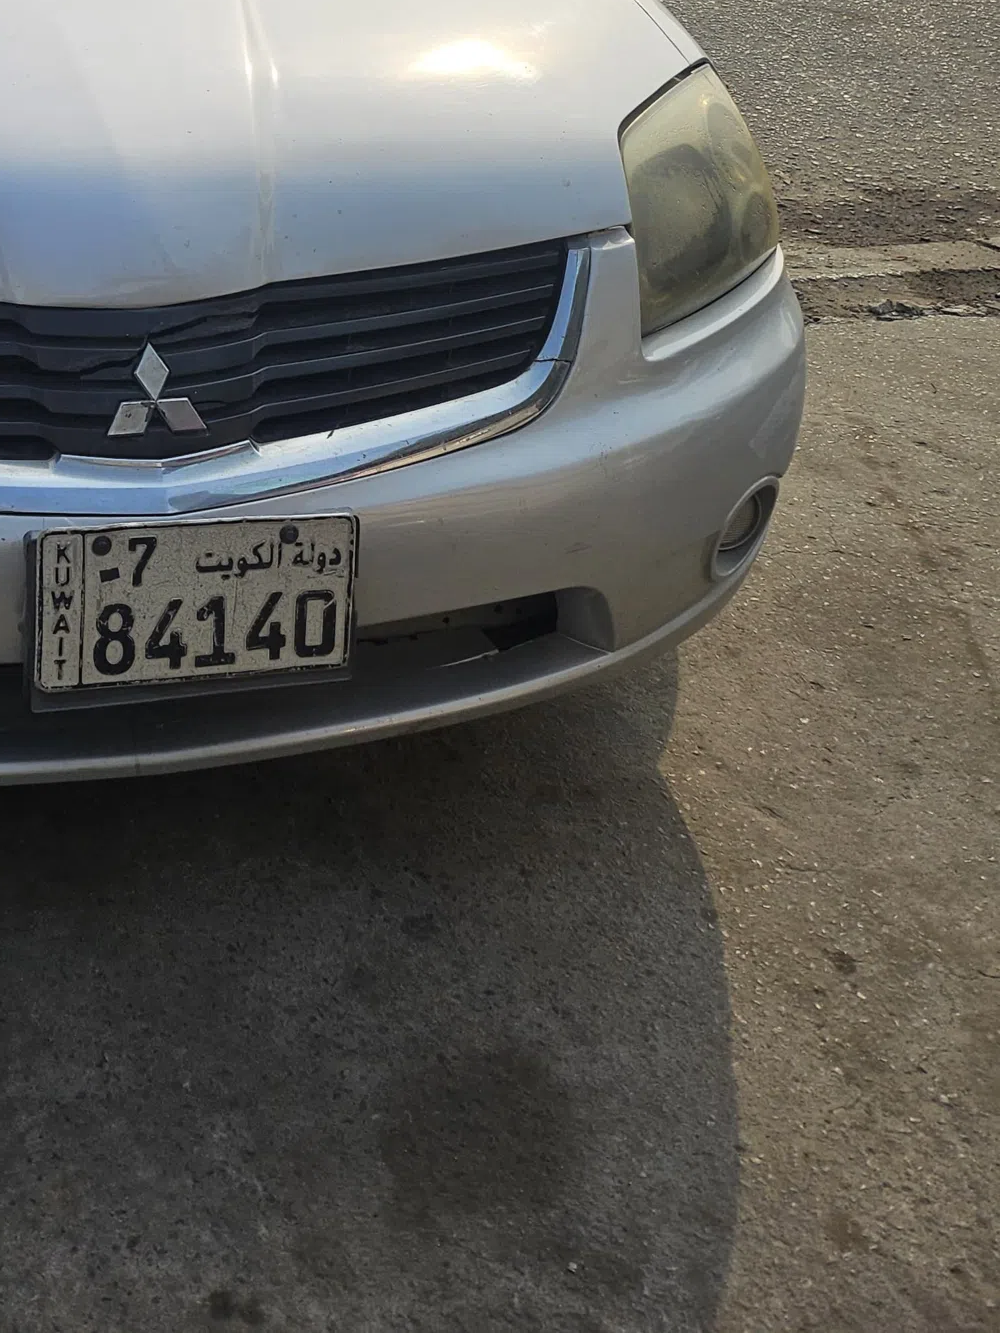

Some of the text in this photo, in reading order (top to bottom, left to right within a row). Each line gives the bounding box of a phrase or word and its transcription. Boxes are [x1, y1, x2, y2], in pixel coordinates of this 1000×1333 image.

[196, 540, 283, 579] الكويت
[52, 541, 76, 681] KUWAIT
[93, 590, 337, 676] 84140
